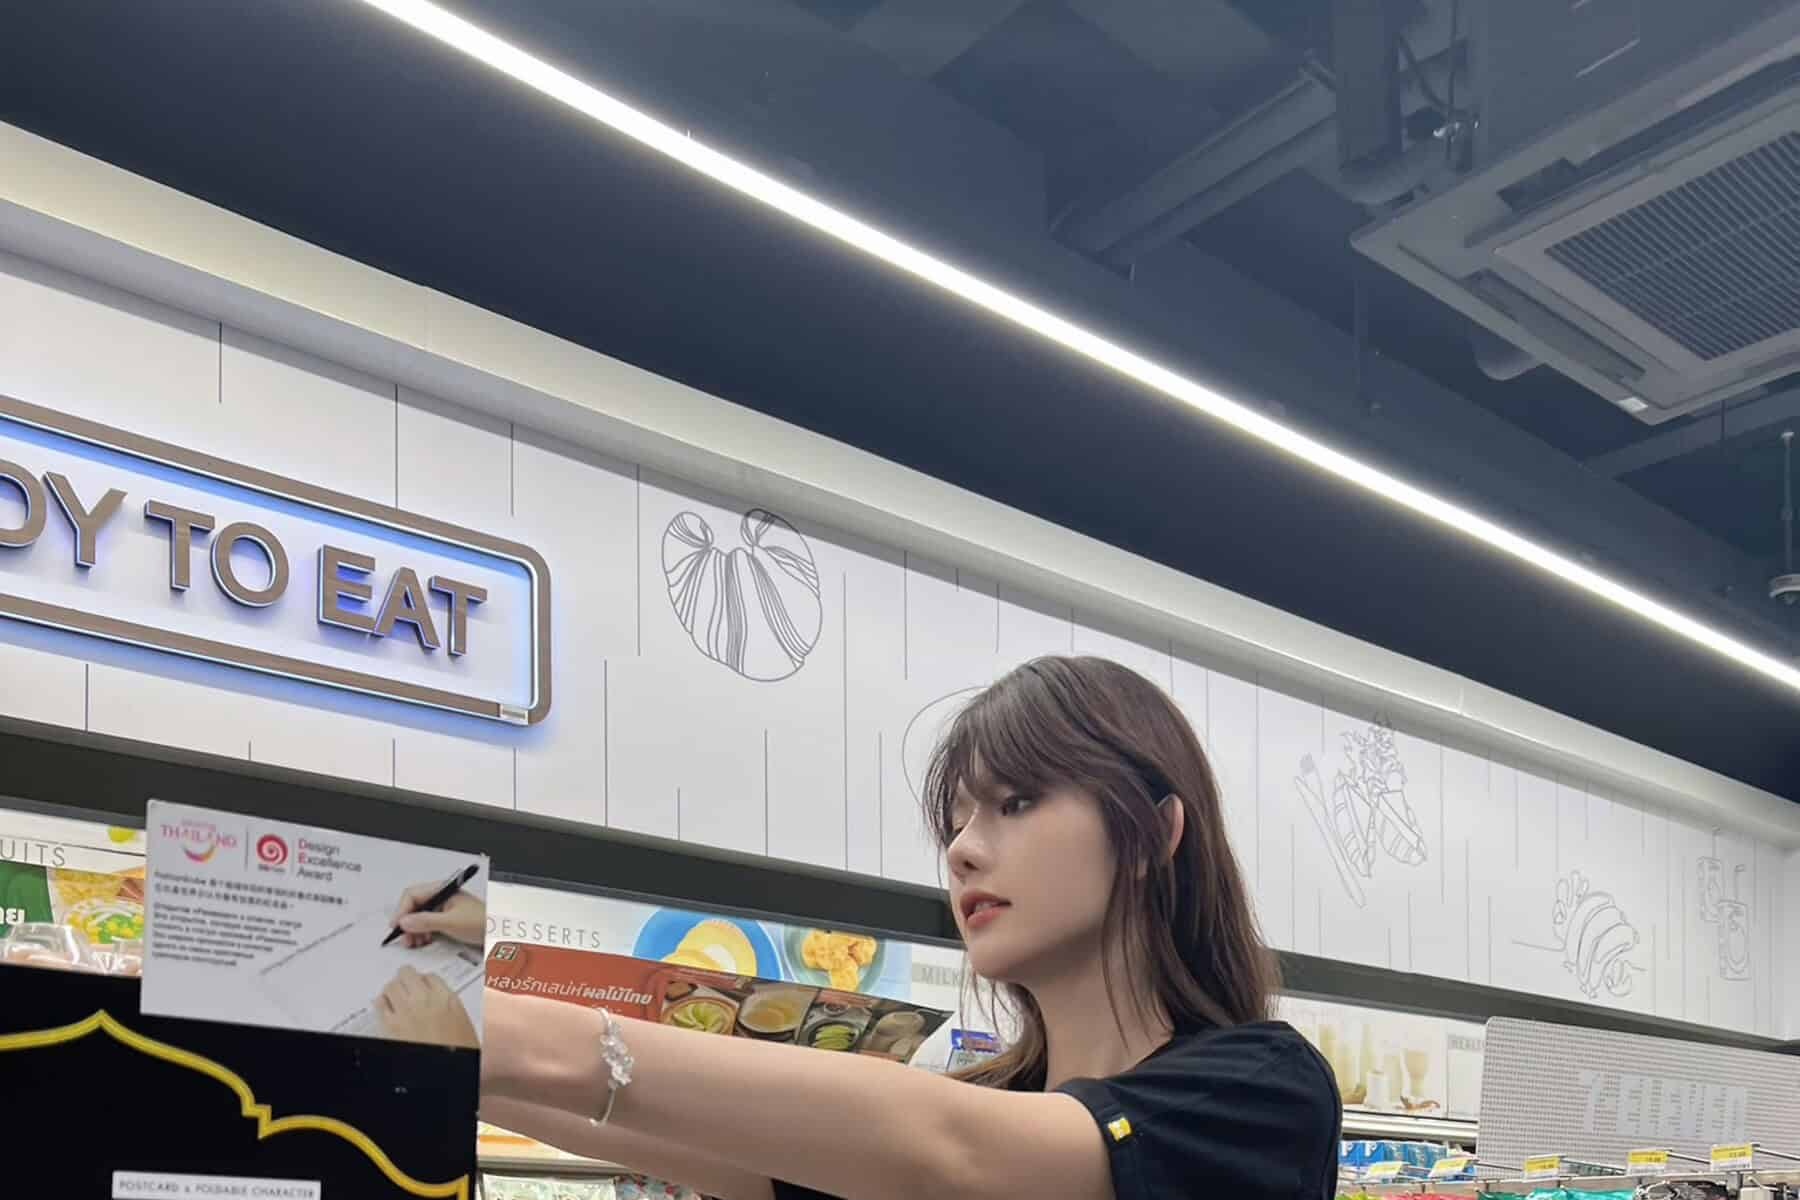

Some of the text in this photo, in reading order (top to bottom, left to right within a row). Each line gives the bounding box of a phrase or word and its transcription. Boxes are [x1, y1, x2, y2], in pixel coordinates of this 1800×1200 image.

[144, 499, 289, 609] TO
[317, 543, 488, 657] EAT
[298, 838, 341, 856] Design
[298, 852, 363, 873] Excellence
[487, 916, 600, 949] DESSERTS
[119, 1179, 179, 1193] POSTCARD
[251, 1185, 315, 1200] CHARACTER
